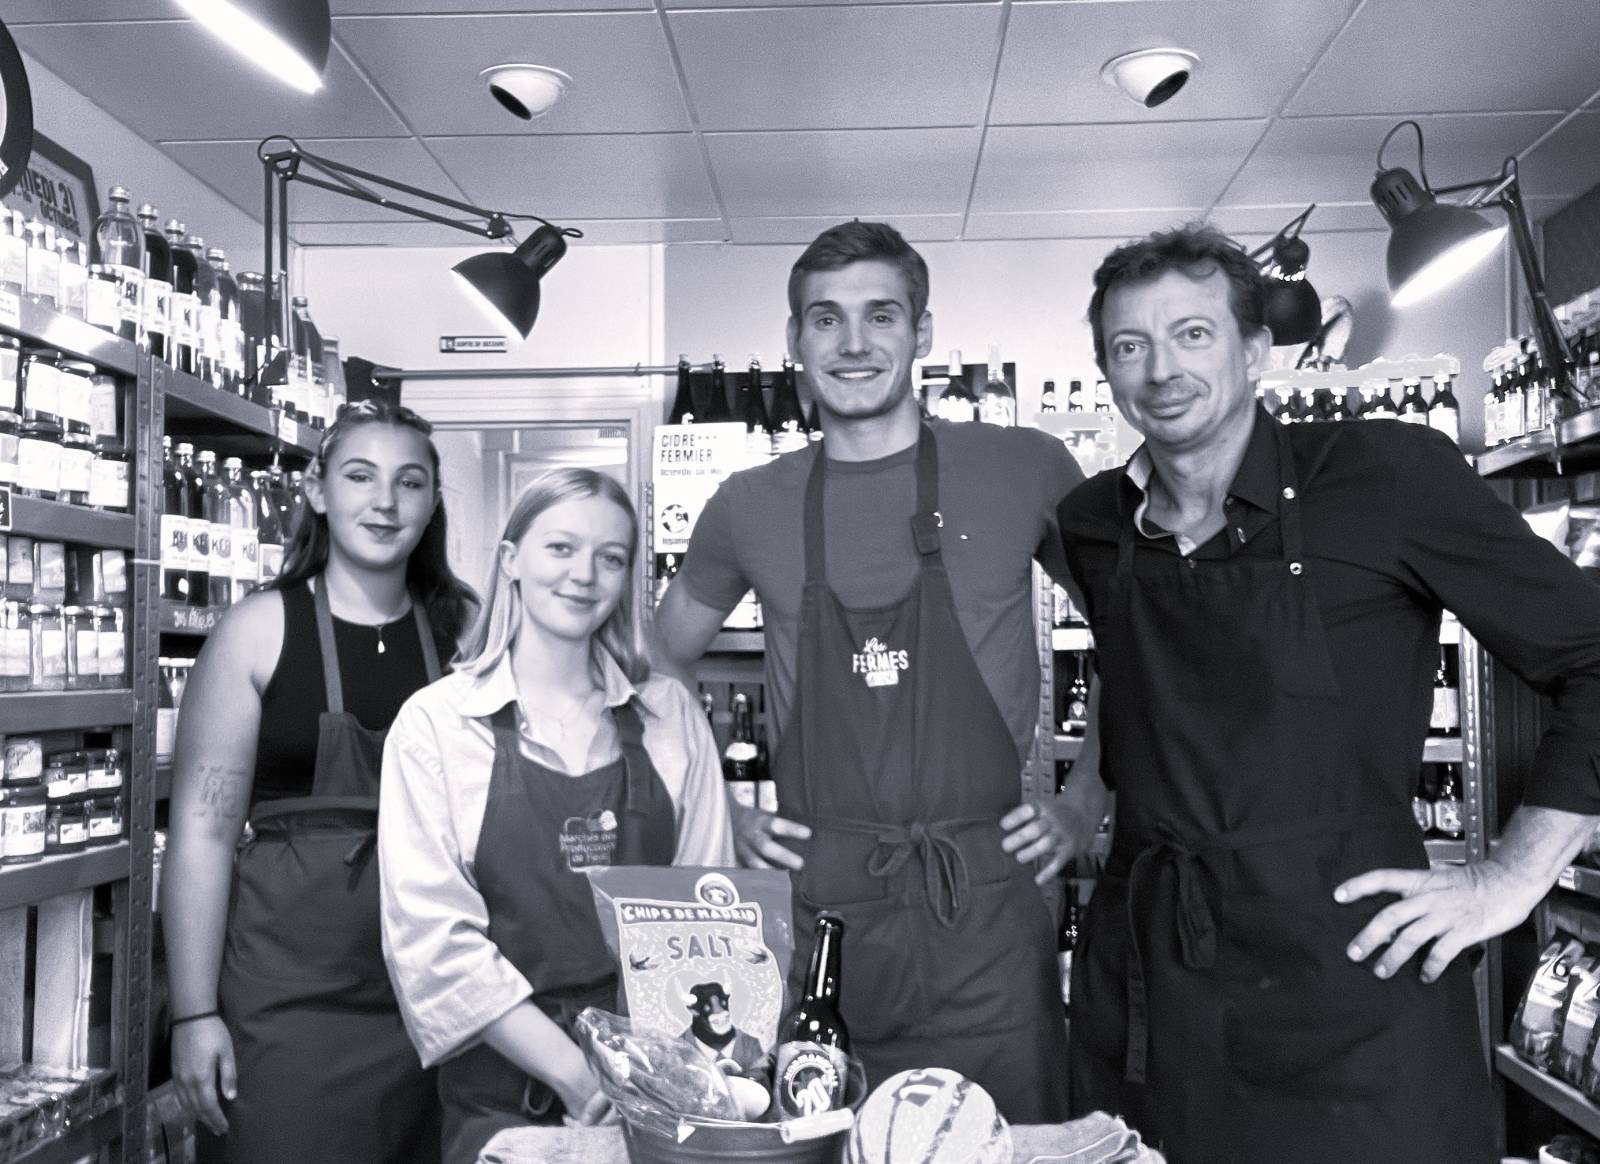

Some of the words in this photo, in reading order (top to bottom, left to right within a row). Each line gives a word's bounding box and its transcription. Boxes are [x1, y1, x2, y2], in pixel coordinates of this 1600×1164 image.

[661, 434, 695, 448] CIDRE
[660, 449, 712, 463] FERMIER
[852, 649, 910, 674] FERMES
[623, 905, 672, 921] CHIPS
[674, 908, 695, 920] DE
[697, 908, 757, 923] MADRID
[667, 934, 732, 960] SALT
